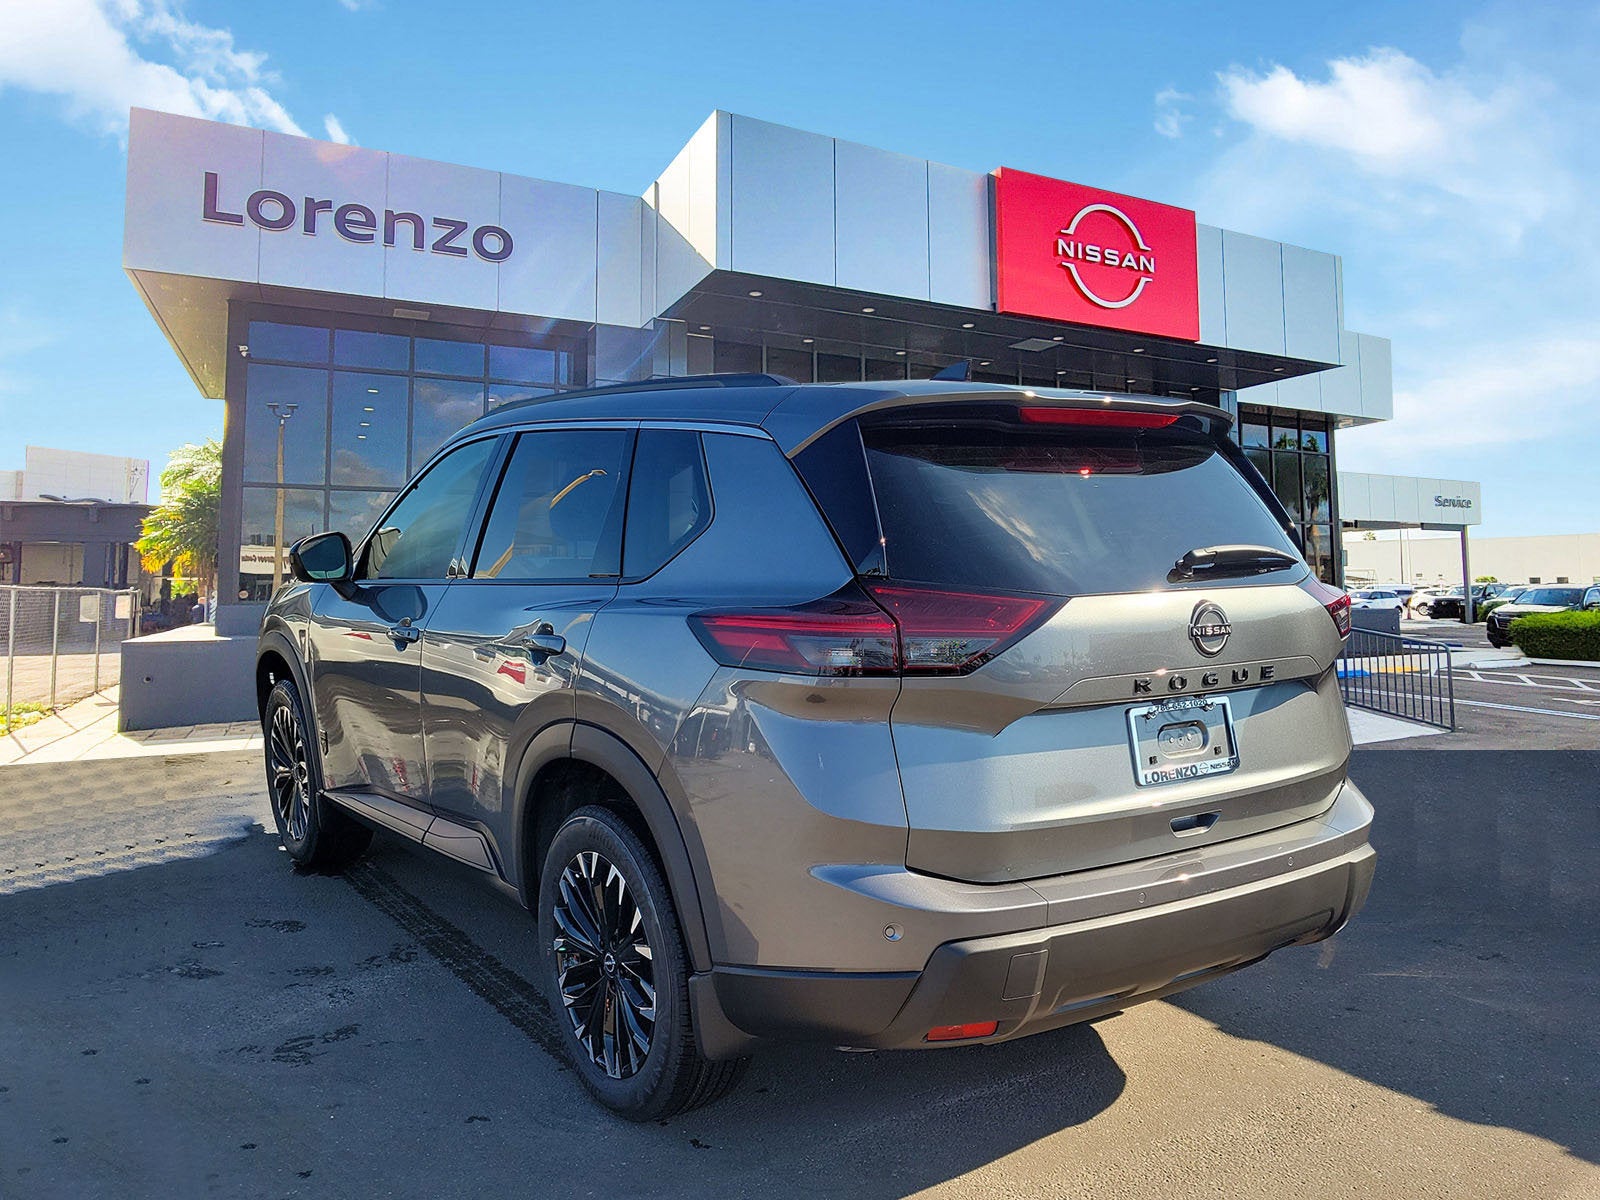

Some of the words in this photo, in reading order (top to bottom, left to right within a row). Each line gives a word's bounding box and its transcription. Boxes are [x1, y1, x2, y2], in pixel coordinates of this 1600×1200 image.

[203, 171, 514, 262] Lorenzo
[1057, 238, 1155, 273] NISSAN
[1434, 495, 1472, 508] Service
[1193, 625, 1232, 636] NISSAN
[1134, 665, 1275, 695] ROGUE
[1144, 764, 1199, 784] LORENZO
